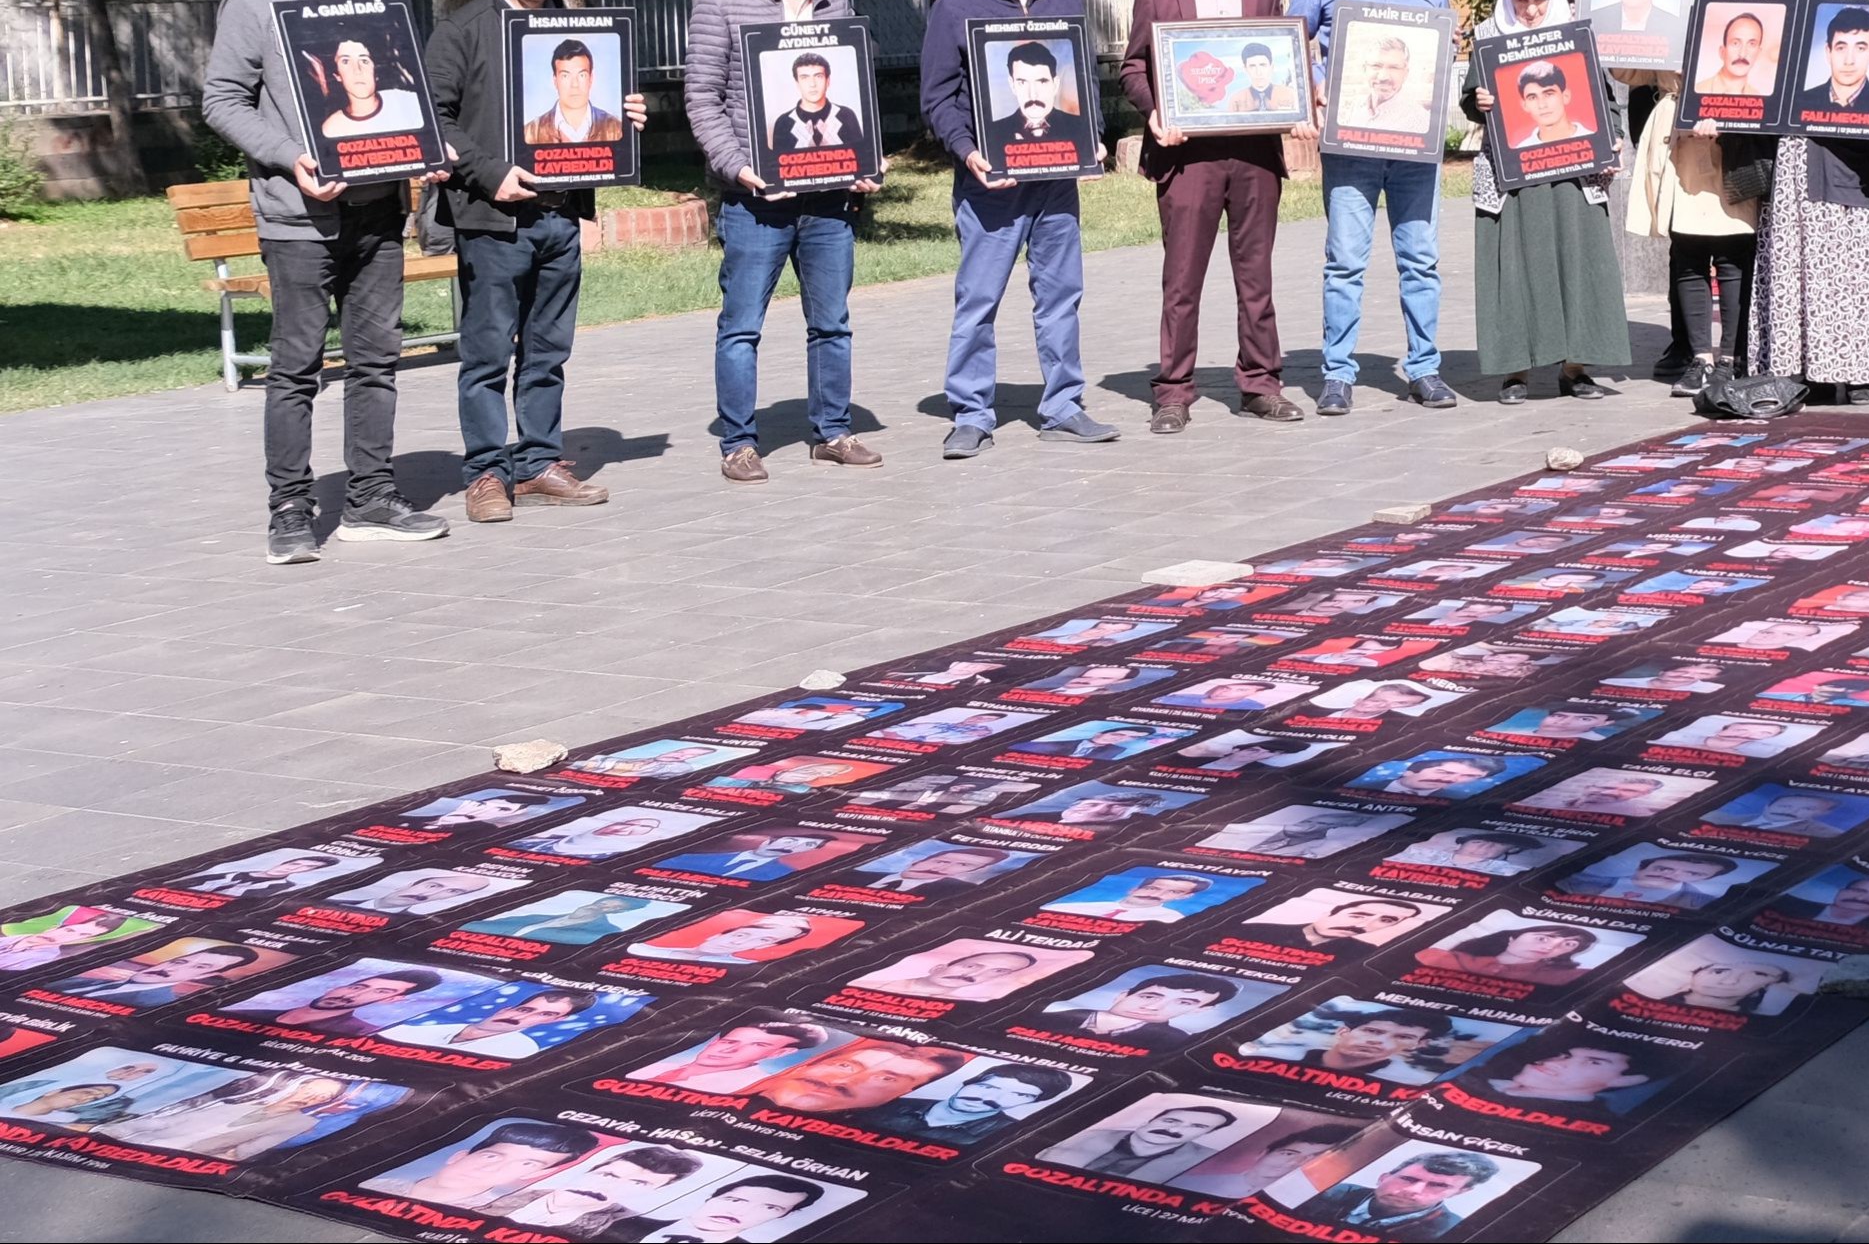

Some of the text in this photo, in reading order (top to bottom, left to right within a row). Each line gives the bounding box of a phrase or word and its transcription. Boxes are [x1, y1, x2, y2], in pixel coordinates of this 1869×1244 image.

[302, 6, 318, 18] A.
[318, 0, 354, 17] GANİ
[1361, 6, 1429, 24] TAHİR ELÇİ
[528, 14, 613, 28] İHSAN HARAN
[780, 23, 831, 37] CÜNEYT
[984, 19, 1070, 33] MEHMET ÖZDEMİR
[778, 35, 839, 49] AYDINLAR
[1505, 30, 1563, 50] M. ZAFER
[1498, 40, 1575, 64] DEMİRKIRAN
[1620, 762, 1715, 779] TAHİR ELÇİ
[950, 834, 1064, 853] FETTAH ERDEM
[1332, 879, 1463, 905] ZEKİ ALABALIK
[1521, 904, 1653, 934] ŞÜKRAN DAŞ
[984, 926, 1102, 951] ALİ TEKDAĞ
[1718, 925, 1803, 955] GÜLNAZ
[1163, 956, 1303, 985] MEHMET TEKDAĞ
[1373, 990, 1457, 1014] MEHMET
[1583, 1018, 1704, 1051] TANRIVERDİ
[1035, 1055, 1099, 1075] BULUT
[1396, 1108, 1530, 1157] İHSAN ÇİÇEK
[556, 1109, 870, 1183] CEZAYİR HASAN SELİM ÖRHAN
[1120, 1203, 1151, 1218] LİCE
